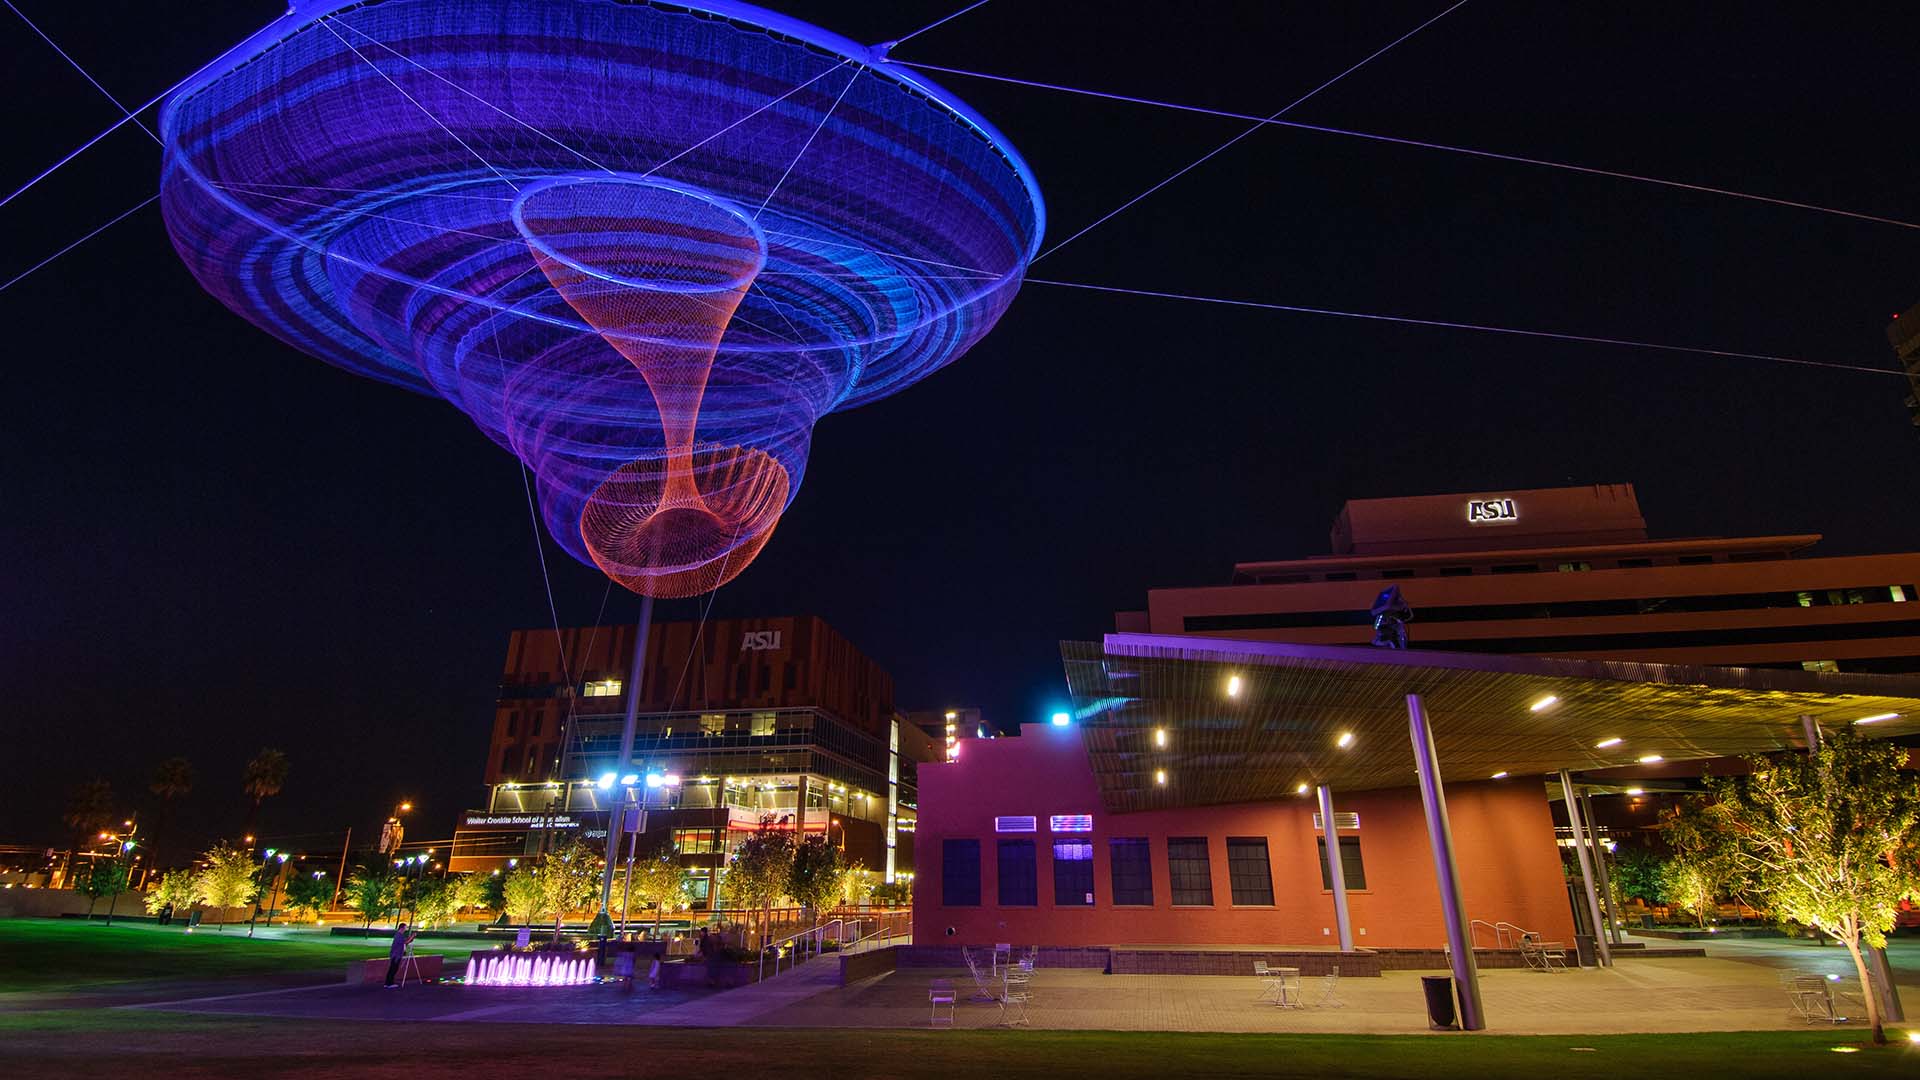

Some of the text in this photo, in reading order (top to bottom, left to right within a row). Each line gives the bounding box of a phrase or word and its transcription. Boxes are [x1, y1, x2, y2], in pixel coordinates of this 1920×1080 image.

[1469, 499, 1517, 521] ASU
[741, 631, 781, 650] ASU
[466, 817, 487, 825] Walter
[487, 816, 511, 824] Cronkite
[511, 816, 531, 824] School
